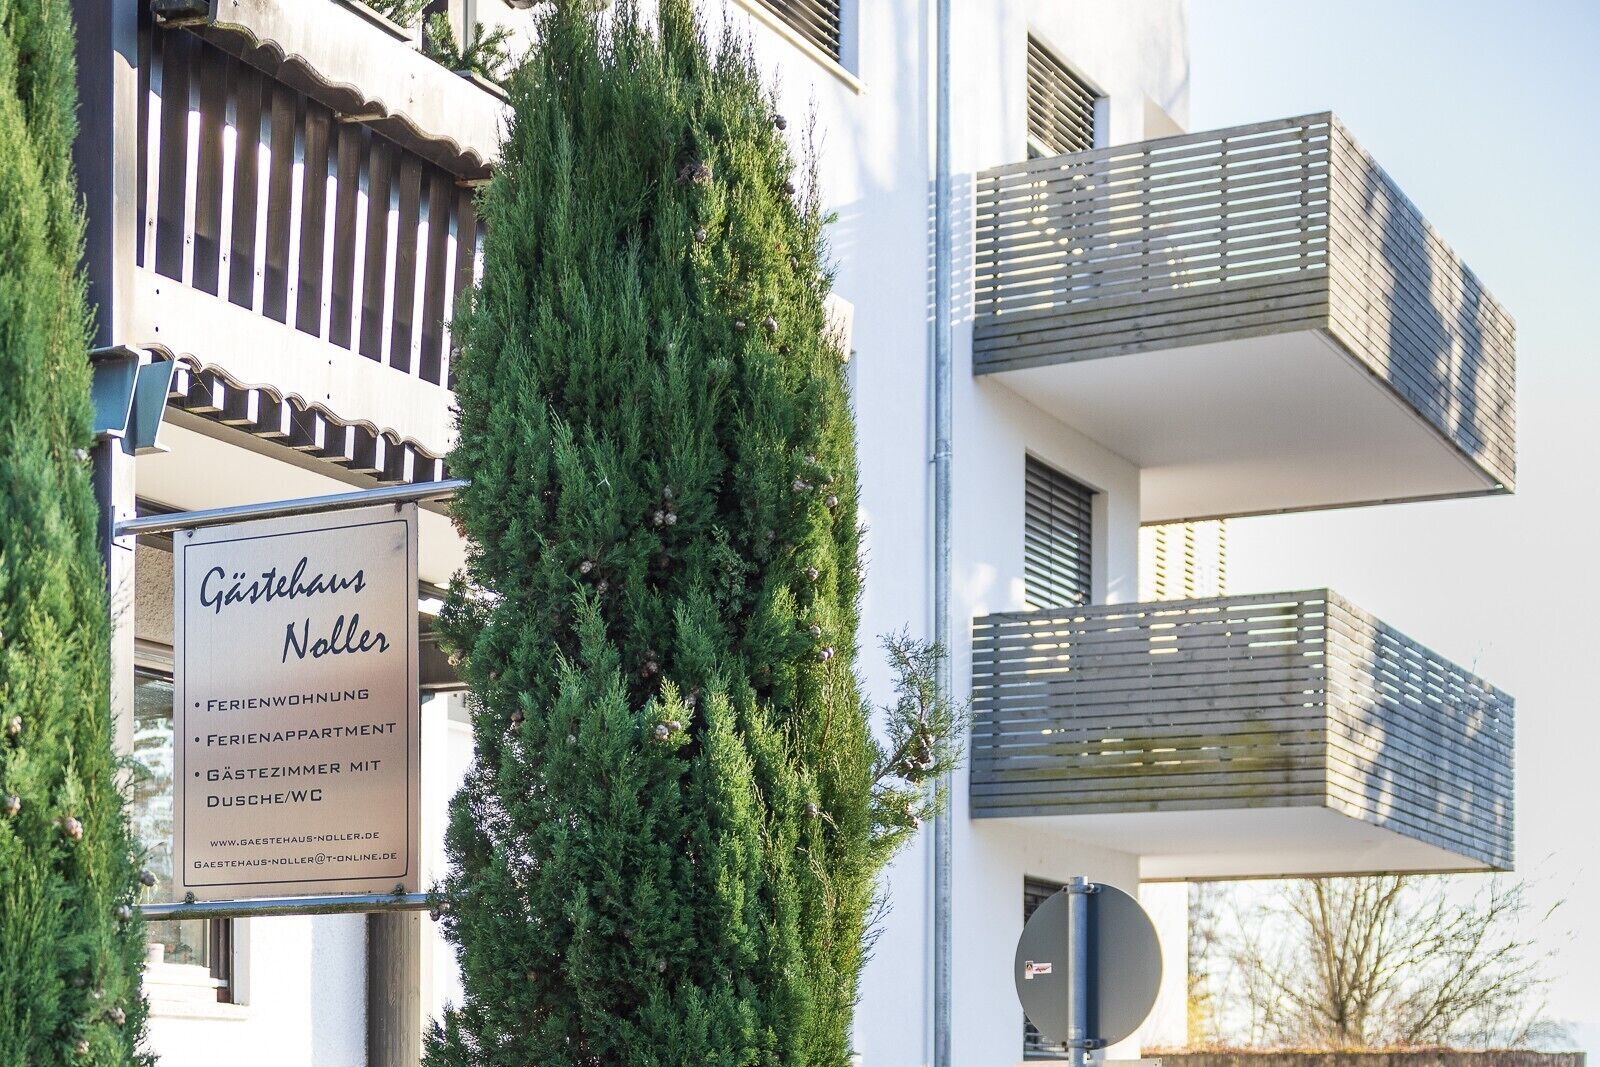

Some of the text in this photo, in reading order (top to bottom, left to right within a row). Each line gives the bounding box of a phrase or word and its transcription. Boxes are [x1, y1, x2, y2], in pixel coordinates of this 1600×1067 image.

[199, 556, 366, 614] Gästehaus
[282, 613, 390, 664] Noller
[207, 688, 369, 712] FERIENWOHNUNG
[207, 722, 397, 747] FERIENAPPARTMENT
[207, 759, 382, 782] GÄSTEZIMMER MIT
[207, 788, 323, 808] DUSCHE/WC
[210, 831, 380, 848] WWW.GAESTEHAUS-NOLLER.DE
[193, 851, 398, 869] GAESTEHAUS-NOLLER@T-ONLINE.DE
